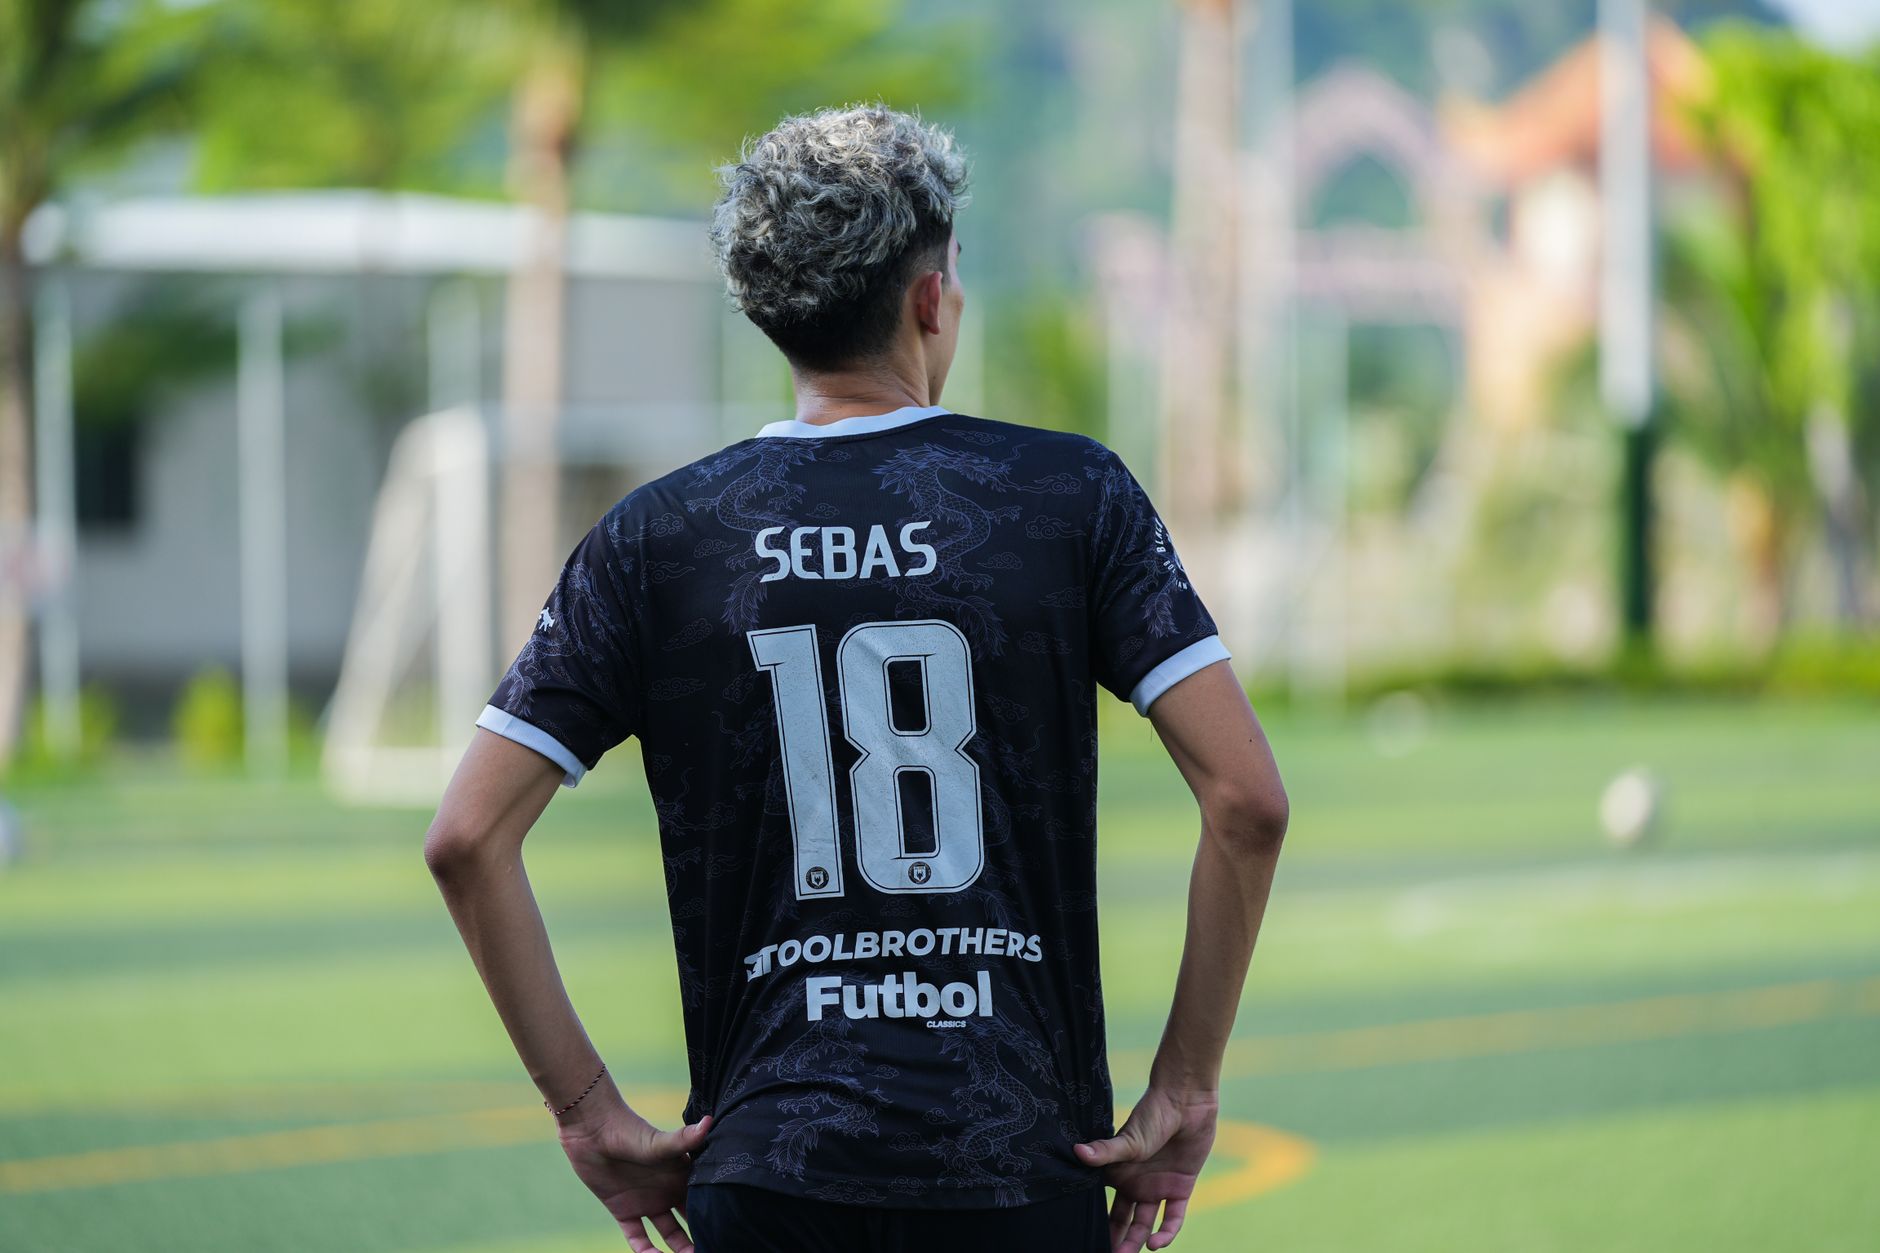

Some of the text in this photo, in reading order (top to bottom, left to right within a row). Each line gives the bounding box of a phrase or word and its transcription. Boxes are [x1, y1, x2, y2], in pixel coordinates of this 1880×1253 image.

[755, 521, 938, 583] SEBAS
[746, 618, 985, 900] 18
[805, 970, 993, 1021] Futbol
[926, 1020, 967, 1028] CLASSICS
